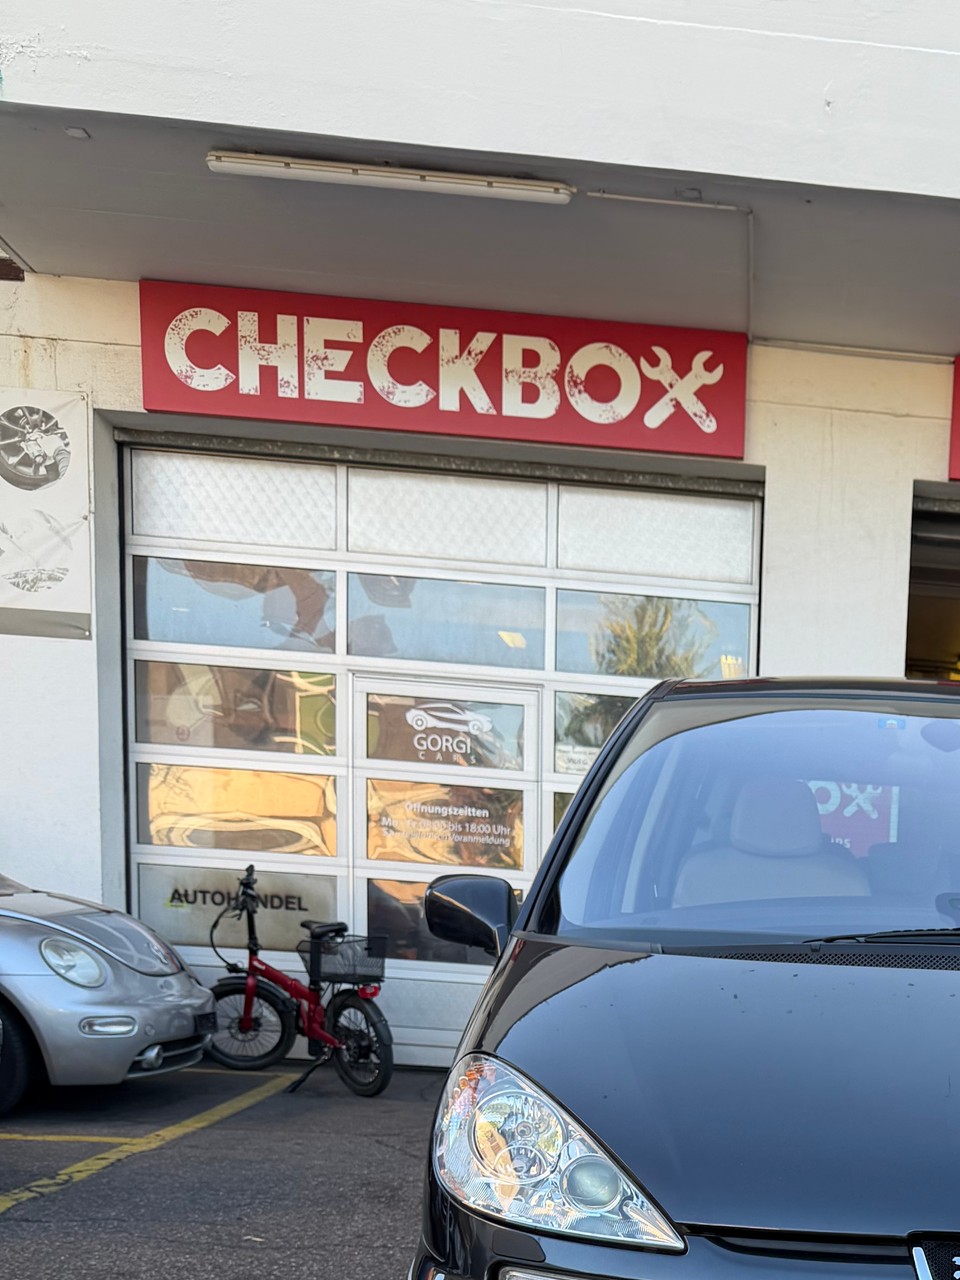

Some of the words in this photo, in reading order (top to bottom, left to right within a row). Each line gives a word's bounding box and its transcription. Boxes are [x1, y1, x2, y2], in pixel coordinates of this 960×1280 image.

[164, 307, 724, 433] CHECKBOX
[413, 734, 471, 754] GORGI
[465, 823, 491, 834] 18:00
[492, 824, 510, 836] Uhr
[170, 889, 308, 912] AUTOHNDEL
